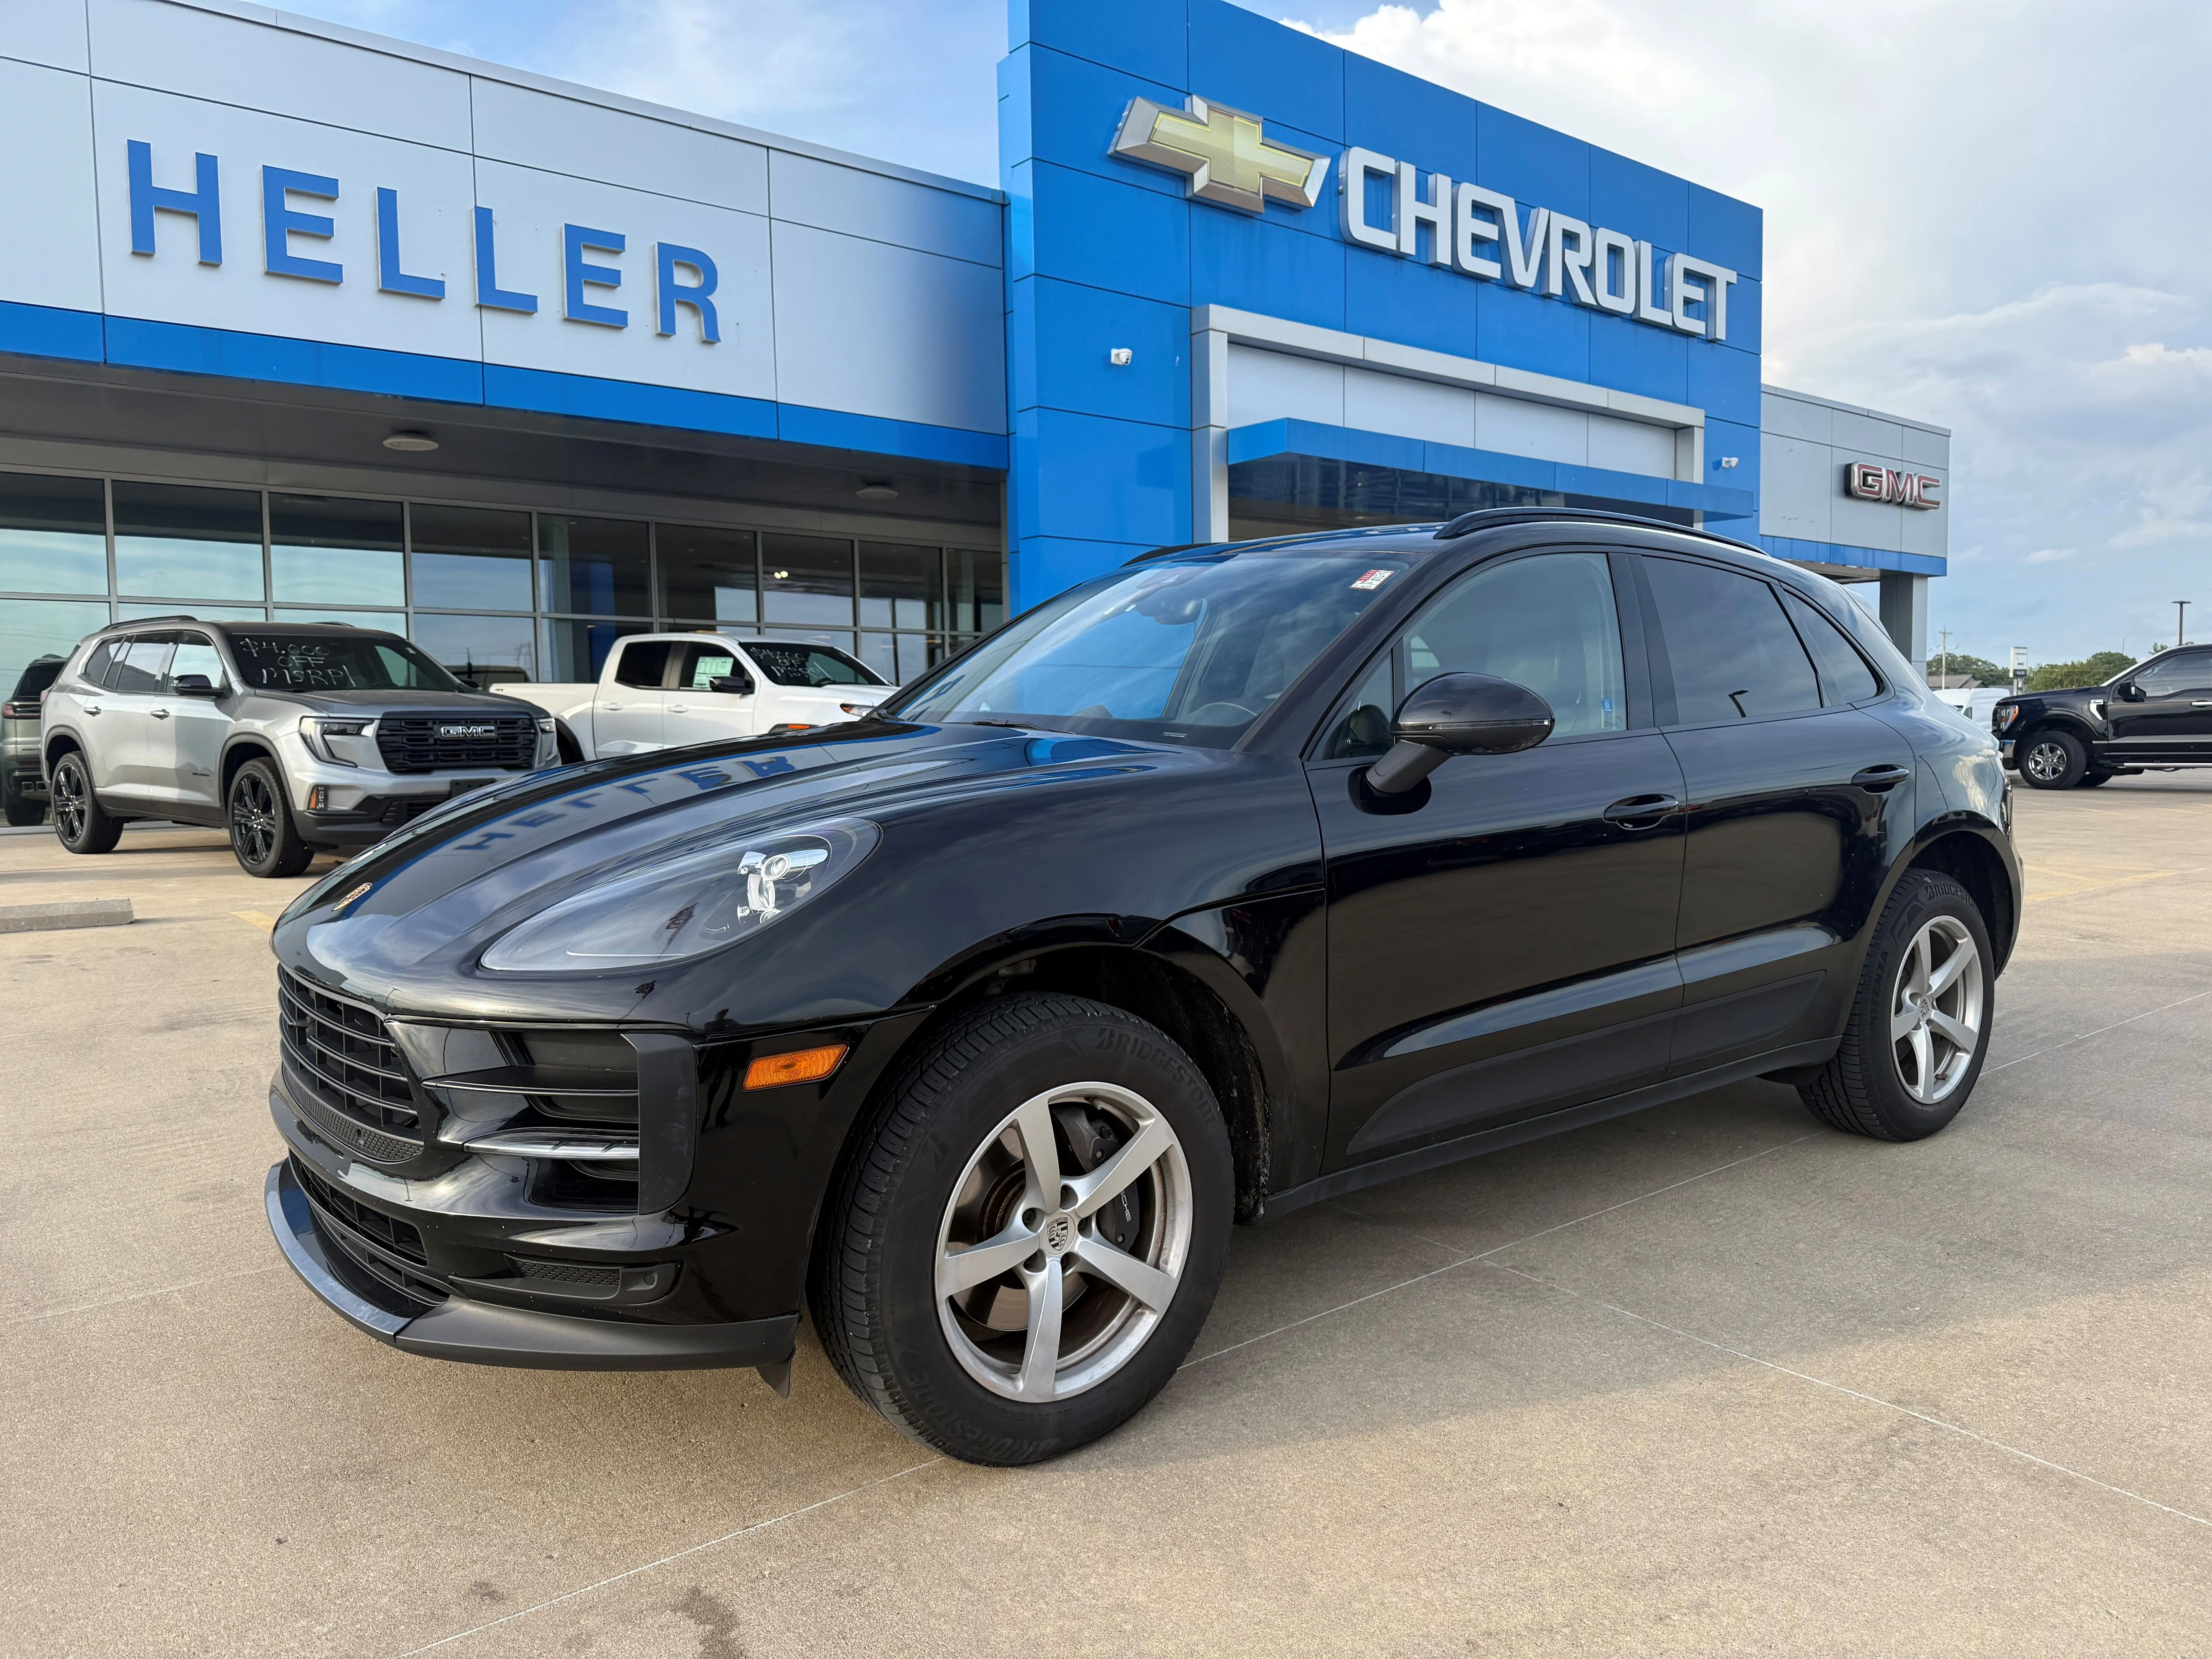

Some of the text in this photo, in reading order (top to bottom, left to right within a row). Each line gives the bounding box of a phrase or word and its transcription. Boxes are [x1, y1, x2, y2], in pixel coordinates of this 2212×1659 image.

[127, 139, 721, 344] HELLER
[1338, 146, 1737, 343] CHEVROLET
[1844, 461, 1941, 510] GMC
[262, 664, 357, 687] MSRP!
[277, 656, 325, 667] OFF
[441, 726, 496, 737] GMC
[1869, 951, 1889, 1032] POTENZA
[1094, 1027, 1219, 1128] BRIDGESTONE
[1120, 1189, 1131, 1222] SCHE
